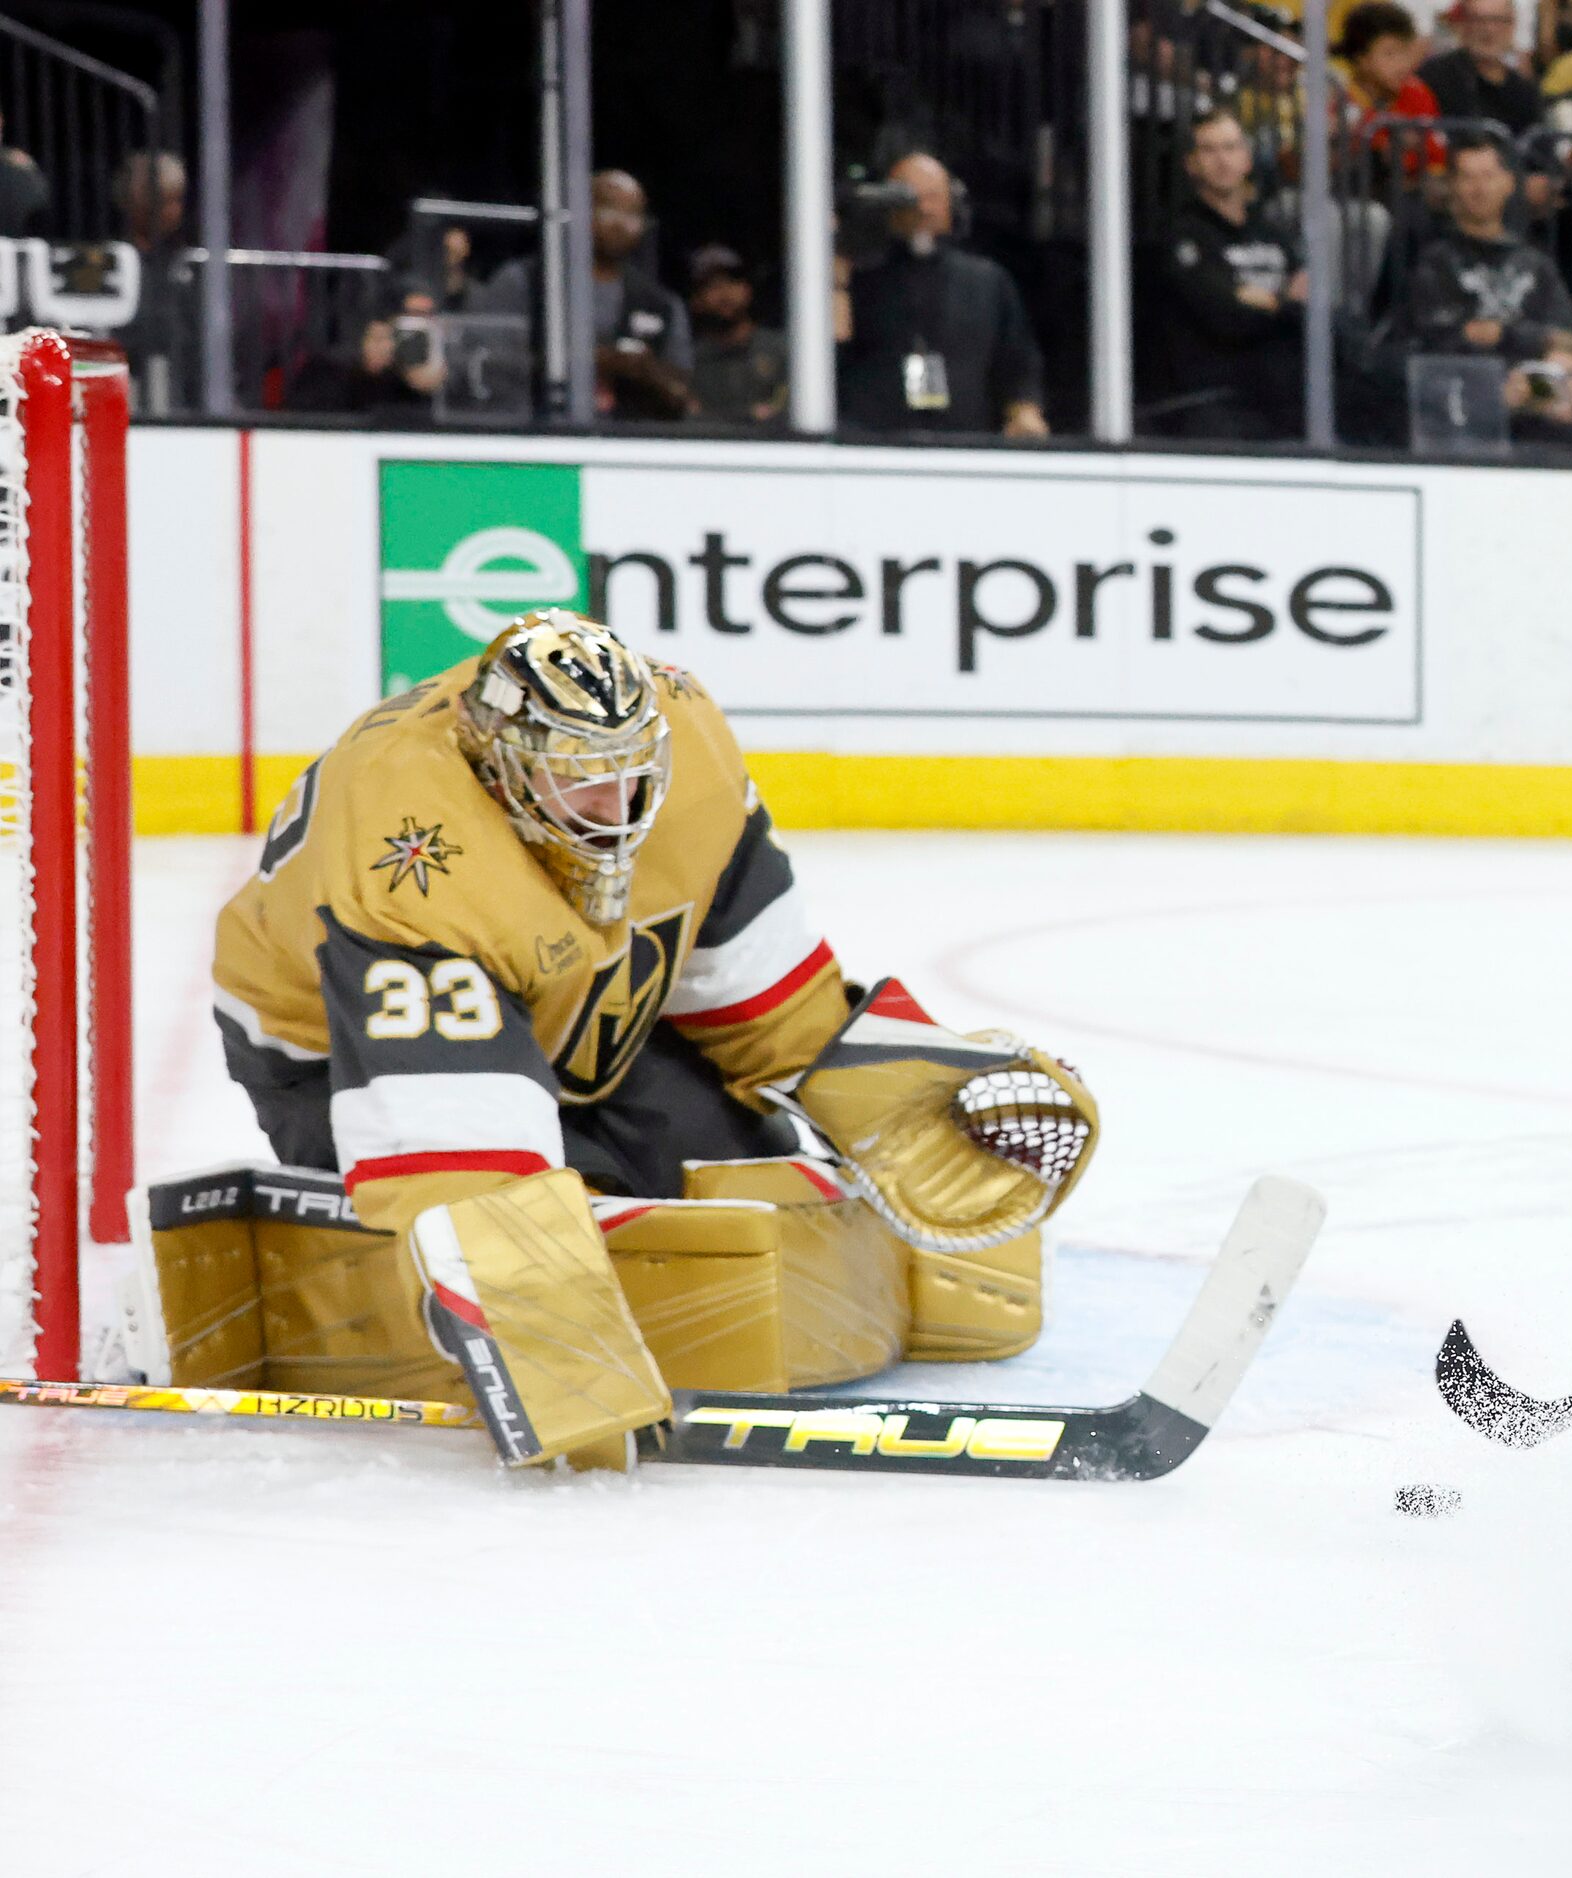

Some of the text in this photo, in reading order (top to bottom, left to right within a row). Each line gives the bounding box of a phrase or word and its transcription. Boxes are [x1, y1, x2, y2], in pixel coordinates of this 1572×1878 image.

[380, 526, 1395, 673] enterprise
[365, 957, 503, 1041] 33
[6, 1384, 130, 1406] TRUE
[256, 1395, 424, 1422] HZRDUS
[465, 1337, 526, 1463] TRUE
[683, 1406, 1066, 1462] TRUE
